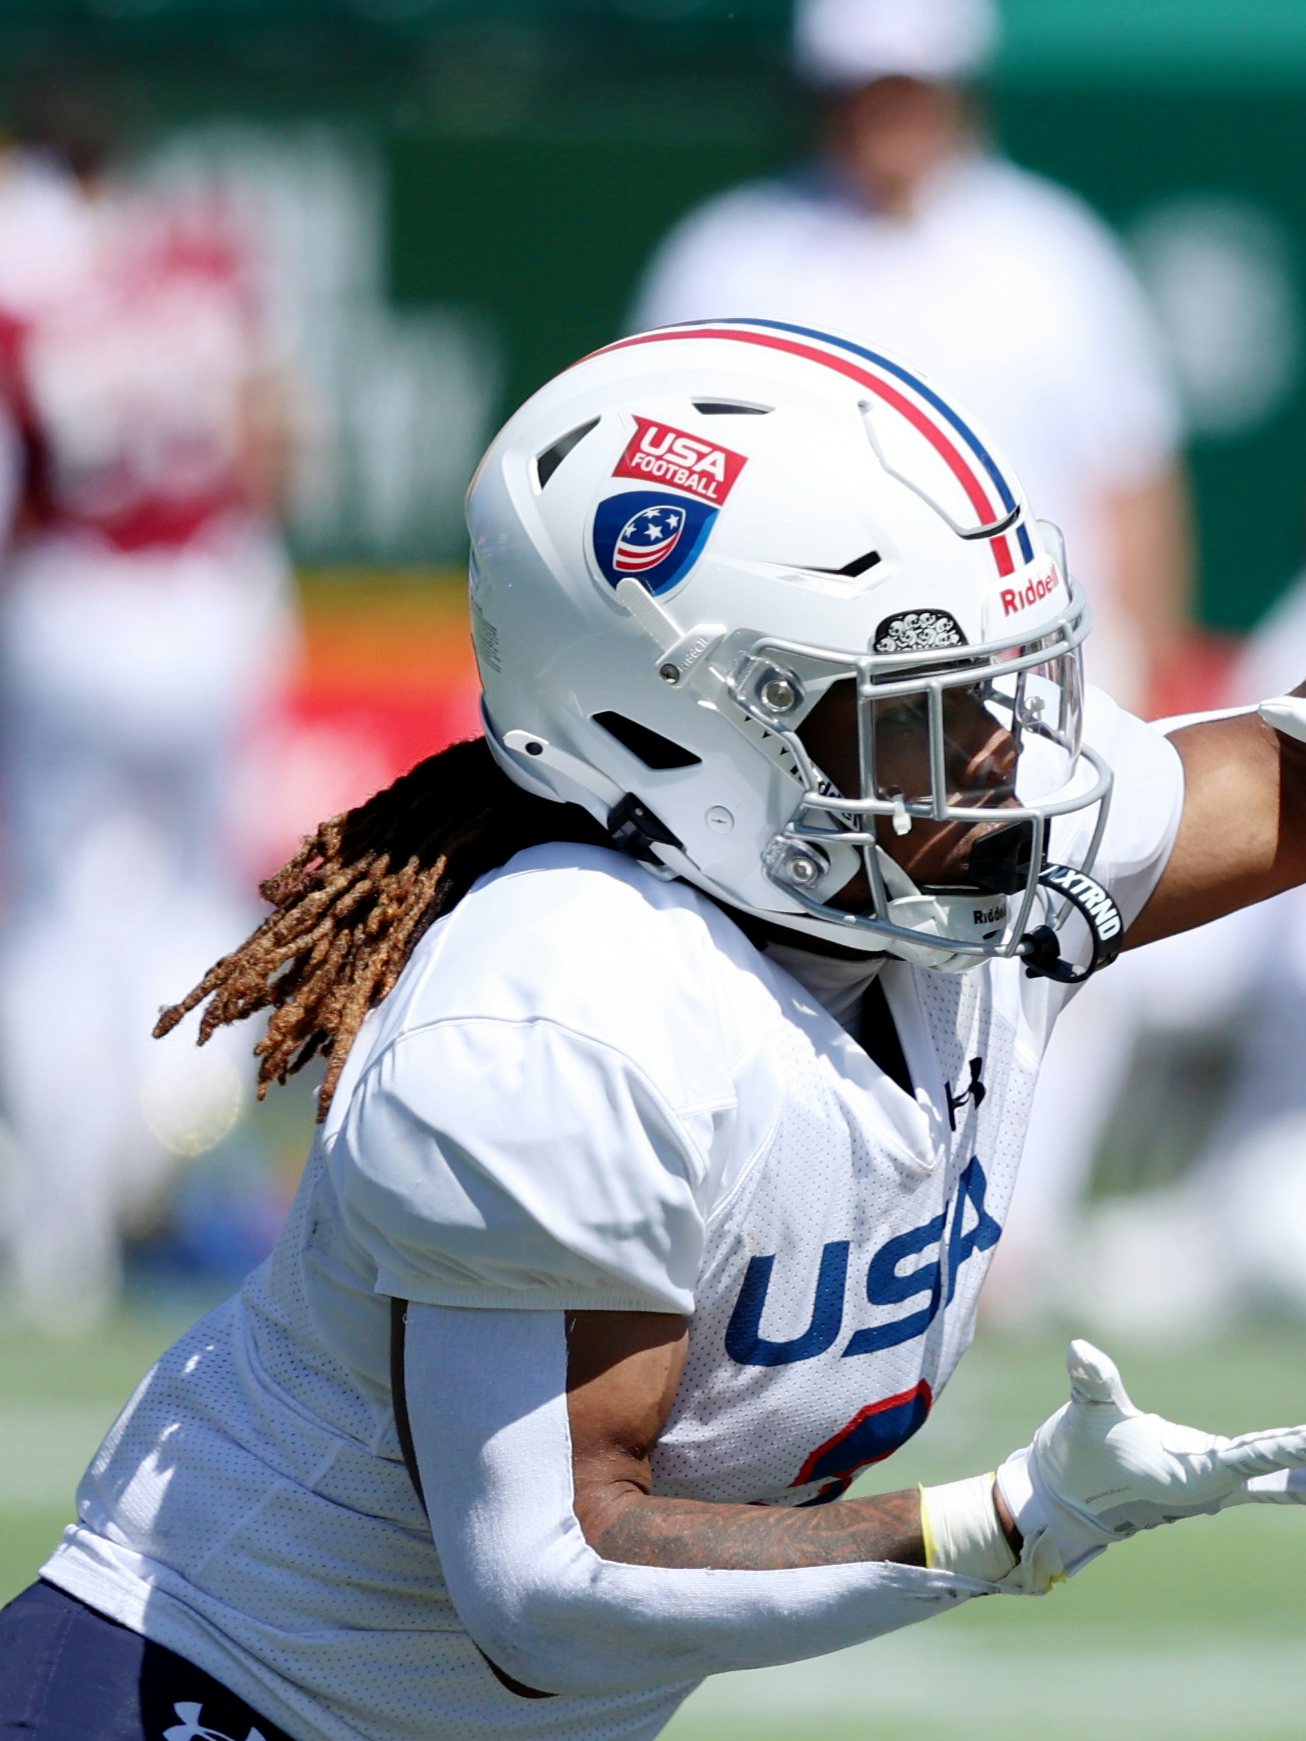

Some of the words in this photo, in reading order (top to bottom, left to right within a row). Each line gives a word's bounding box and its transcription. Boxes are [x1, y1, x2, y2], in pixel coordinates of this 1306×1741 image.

[630, 451, 719, 499] FOOTBALL
[639, 426, 727, 483] USA
[724, 1154, 1003, 1367] USA
